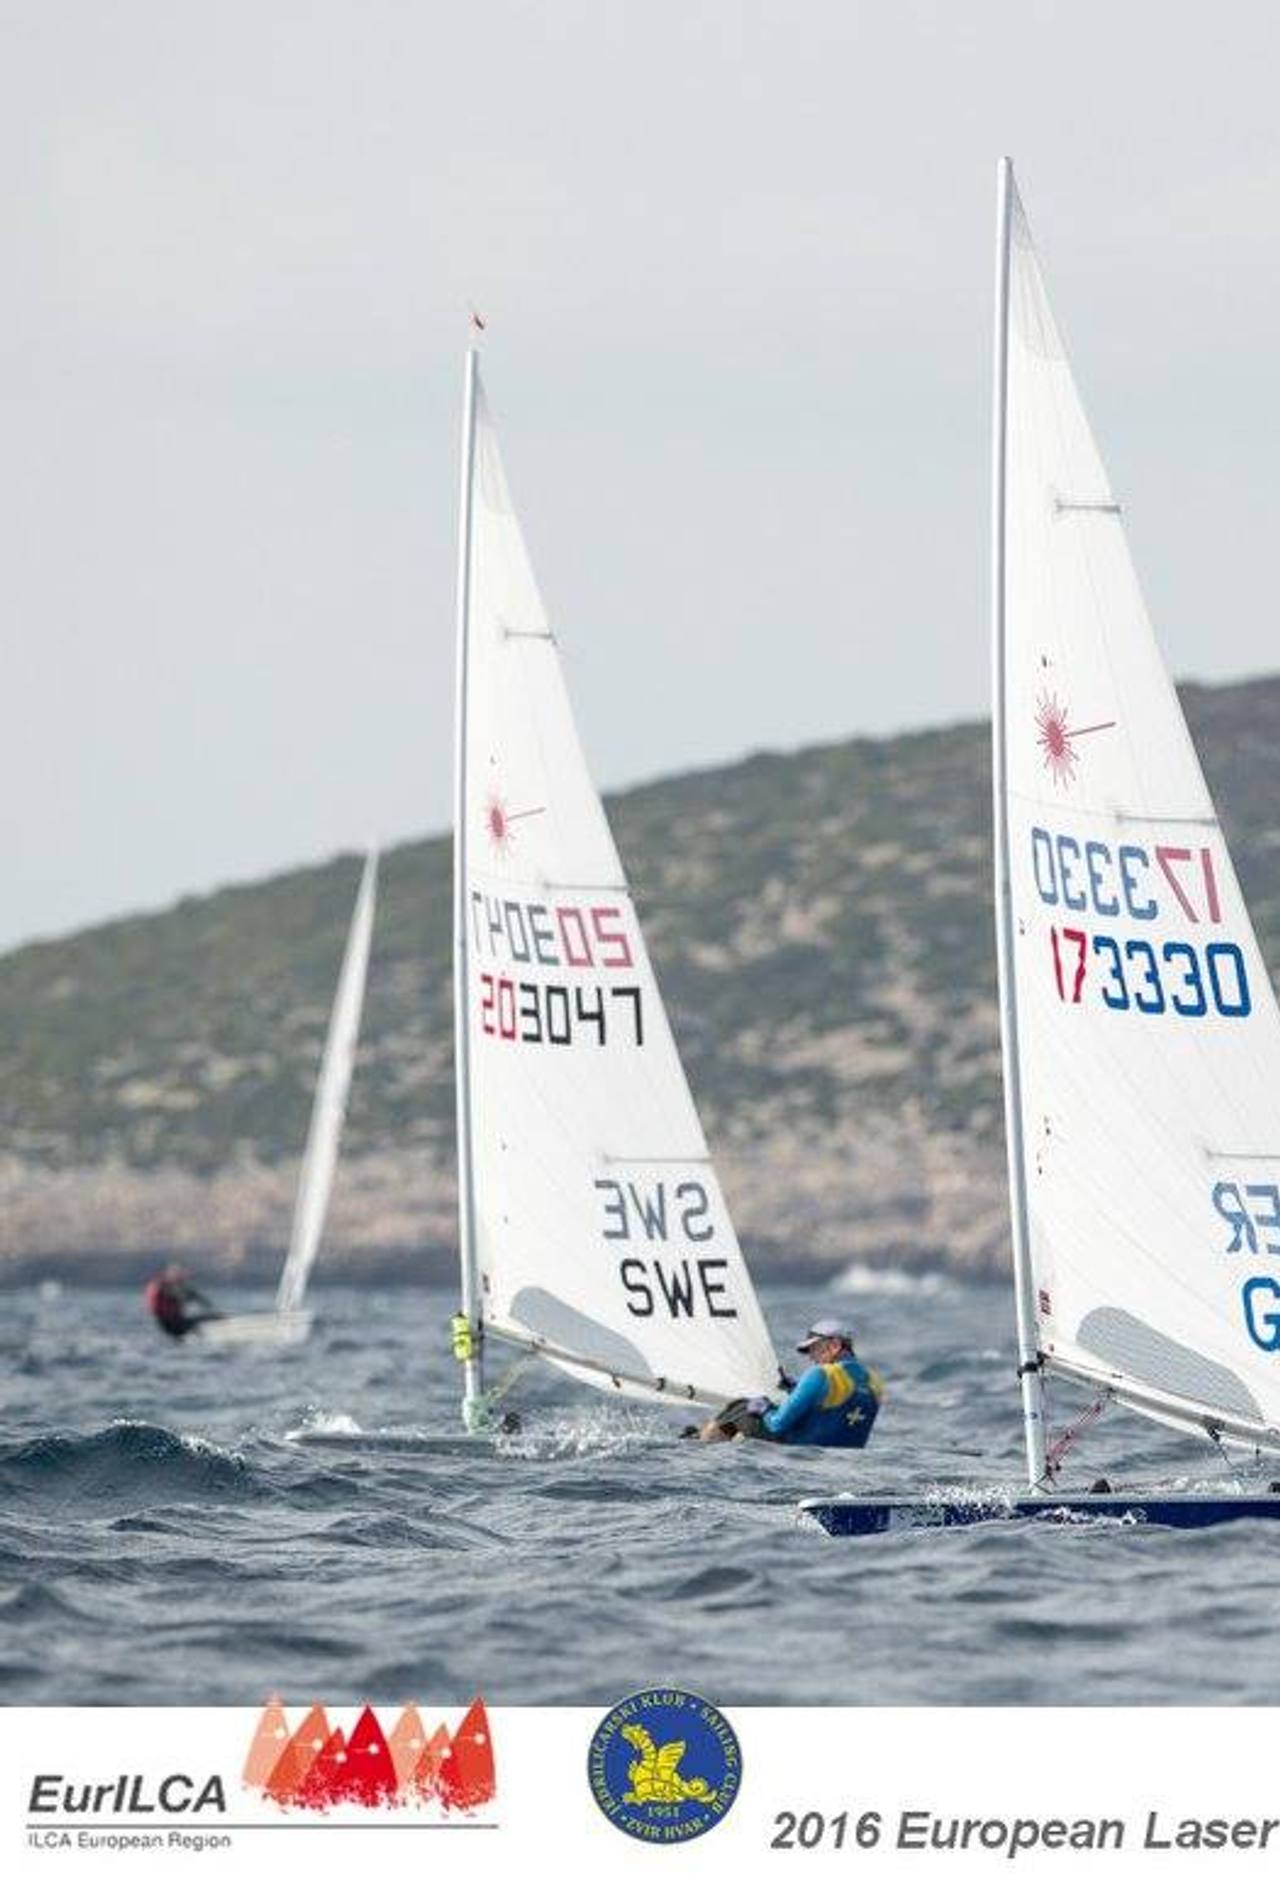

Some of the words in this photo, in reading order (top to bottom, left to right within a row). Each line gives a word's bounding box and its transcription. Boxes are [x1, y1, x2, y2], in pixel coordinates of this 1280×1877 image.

[1050, 926, 1252, 1018] 173330
[480, 973, 643, 1046] 203047
[620, 1259, 737, 1318] SWE
